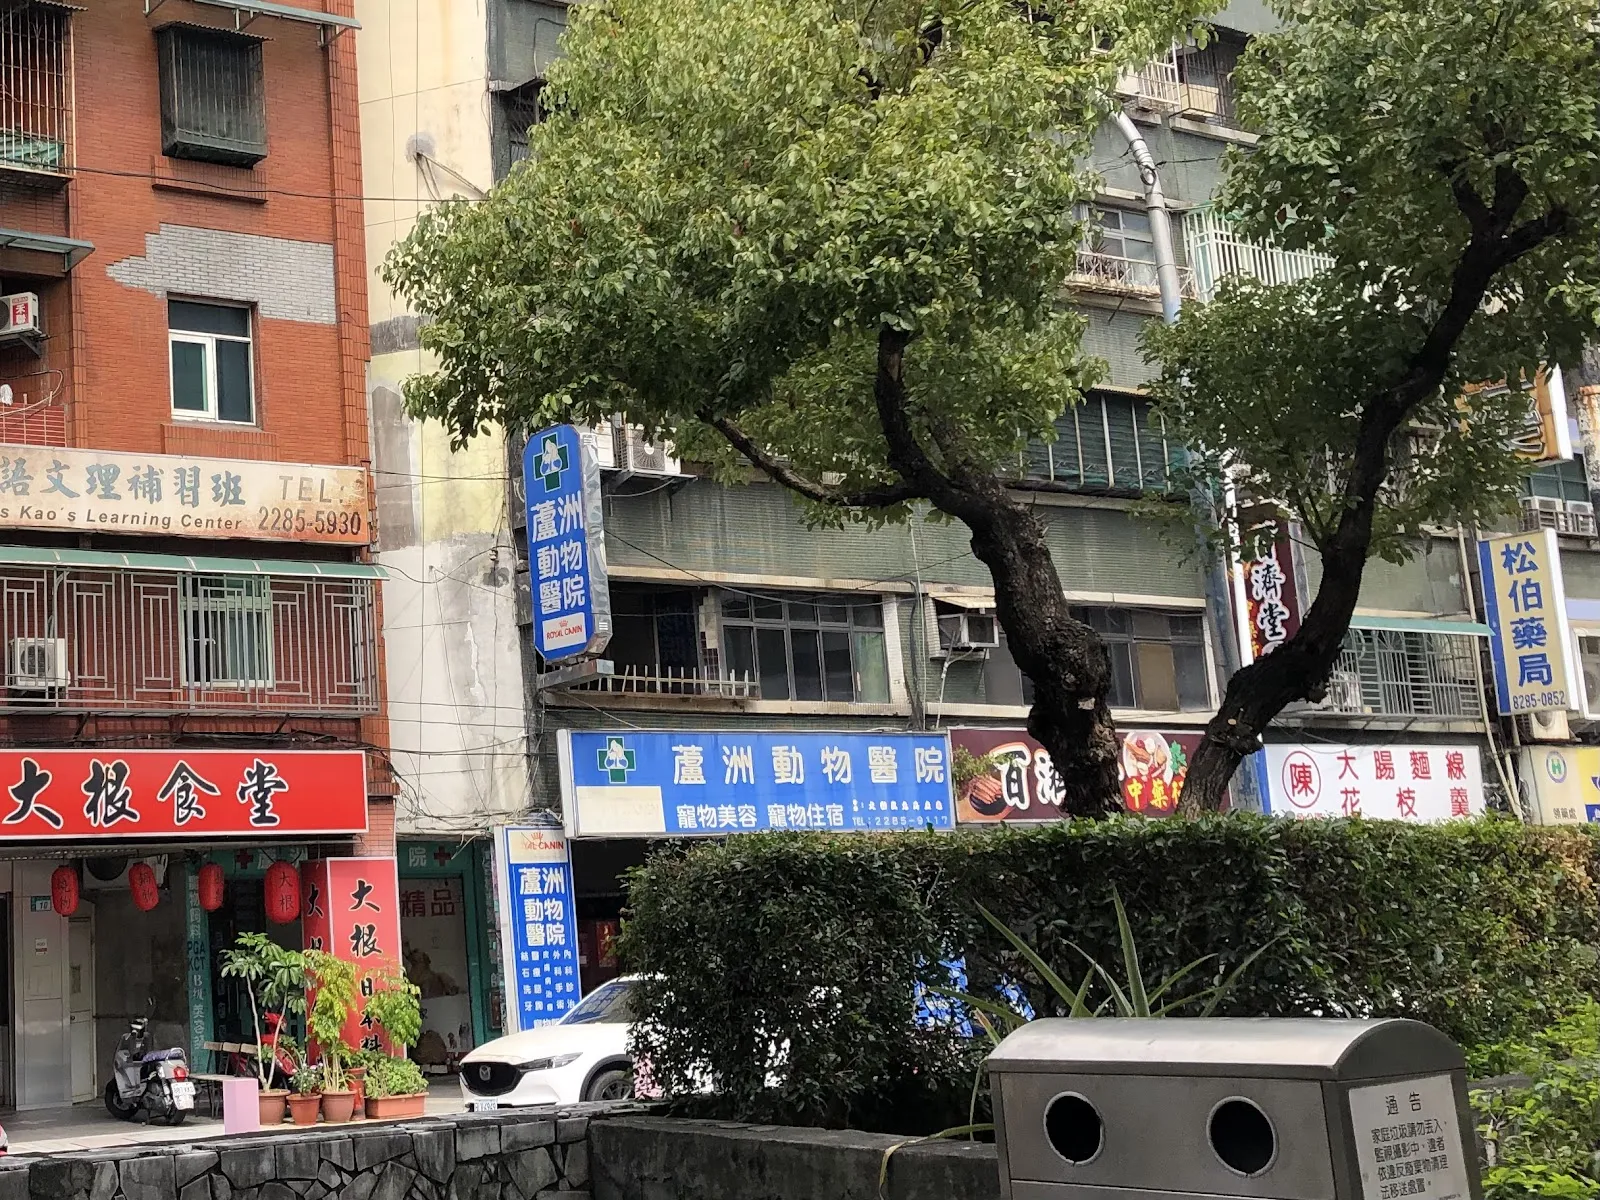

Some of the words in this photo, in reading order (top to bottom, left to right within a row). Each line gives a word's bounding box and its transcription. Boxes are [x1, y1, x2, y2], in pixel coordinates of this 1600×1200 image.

[0, 456, 246, 507] 語文理補習班
[86, 509, 172, 529] Learning
[181, 514, 242, 531] Center
[258, 506, 362, 536] 2285-5930
[531, 491, 584, 543] 蘆洲
[537, 538, 583, 580] 動物
[540, 574, 585, 615] 醫院
[1501, 541, 1553, 688] 松伯藥局
[546, 628, 564, 640] ROYAL
[564, 625, 583, 636] CANIN
[1513, 690, 1566, 710] 8285-0852
[671, 744, 945, 785] 蘆洲動物醫院
[1336, 750, 1468, 781] 大腸麵線
[2, 757, 289, 830] 大根食堂
[1289, 763, 1315, 797] 陳
[676, 803, 757, 829] 寵物美容
[767, 803, 844, 828] 寵物住宿
[1341, 788, 1471, 818] 花枝羹
[408, 846, 427, 868] 院
[539, 841, 564, 850] CANIN
[280, 872, 294, 913] 大根
[518, 867, 565, 896] 蘆洲
[401, 889, 455, 917] 精品
[524, 898, 563, 922] 動物
[187, 941, 205, 955] PGA
[526, 924, 566, 947] 醫院
[187, 957, 205, 971] KCT
